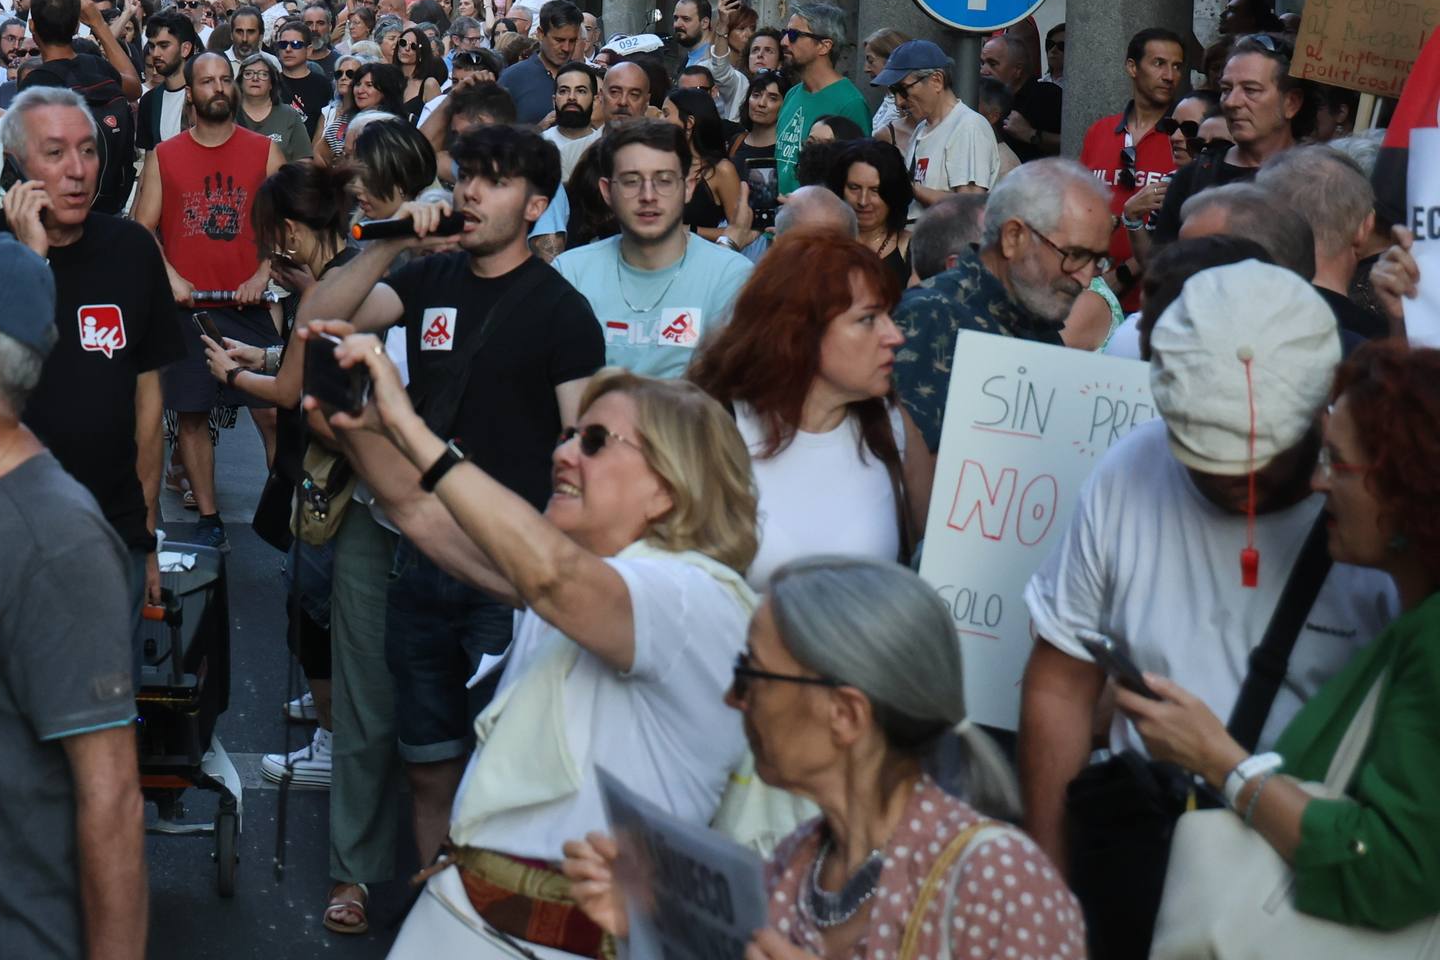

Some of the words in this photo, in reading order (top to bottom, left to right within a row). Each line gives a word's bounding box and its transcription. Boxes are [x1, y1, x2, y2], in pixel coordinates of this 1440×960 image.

[619, 38, 639, 49] 092
[1412, 206, 1440, 241] EC
[1089, 396, 1156, 447] PRE
[947, 460, 1058, 546] NO
